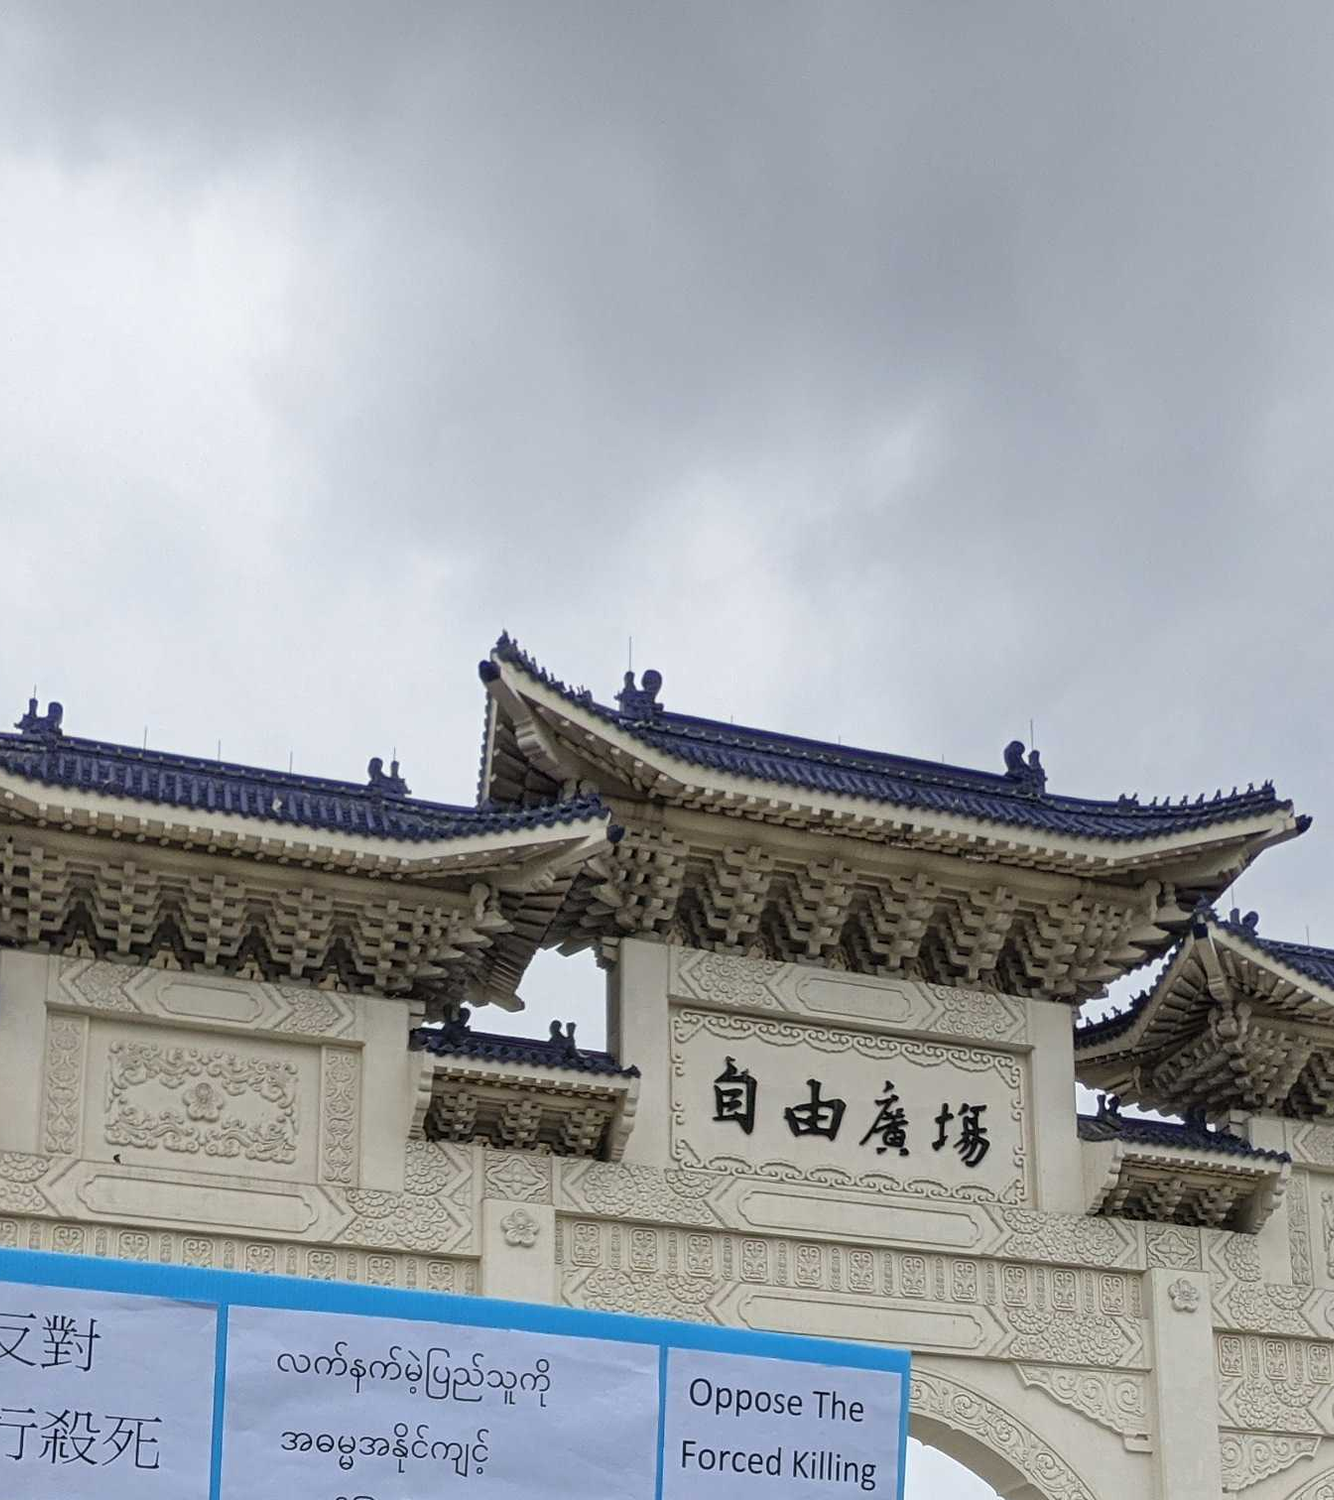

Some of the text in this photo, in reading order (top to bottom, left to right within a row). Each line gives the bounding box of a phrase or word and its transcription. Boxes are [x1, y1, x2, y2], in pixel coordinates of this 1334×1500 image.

[689, 1378, 864, 1422] Oppose The
[681, 1440, 877, 1491] Forced Killing
